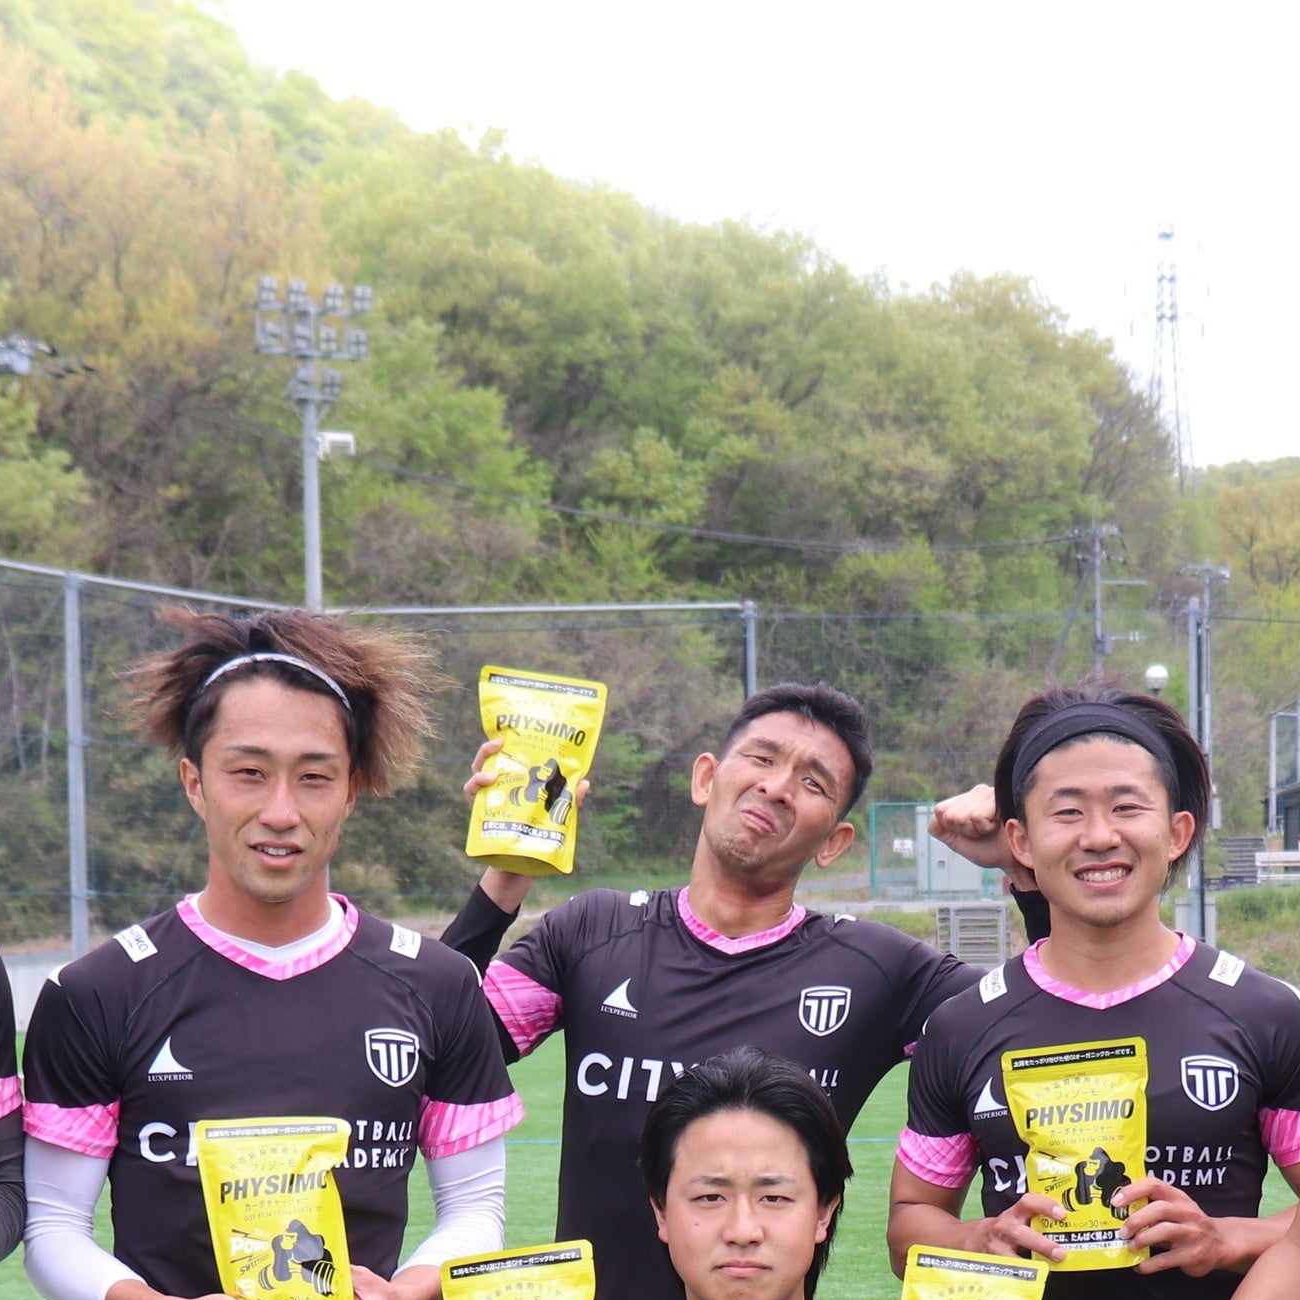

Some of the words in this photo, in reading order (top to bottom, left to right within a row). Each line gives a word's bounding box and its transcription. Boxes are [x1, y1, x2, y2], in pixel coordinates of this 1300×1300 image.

[496, 713, 585, 747] PHYSIIMO
[147, 1073, 194, 1082] LUXPERIOR
[1026, 1098, 1134, 1129] PHYSIIMO
[1145, 1146, 1233, 1164] OTBALL
